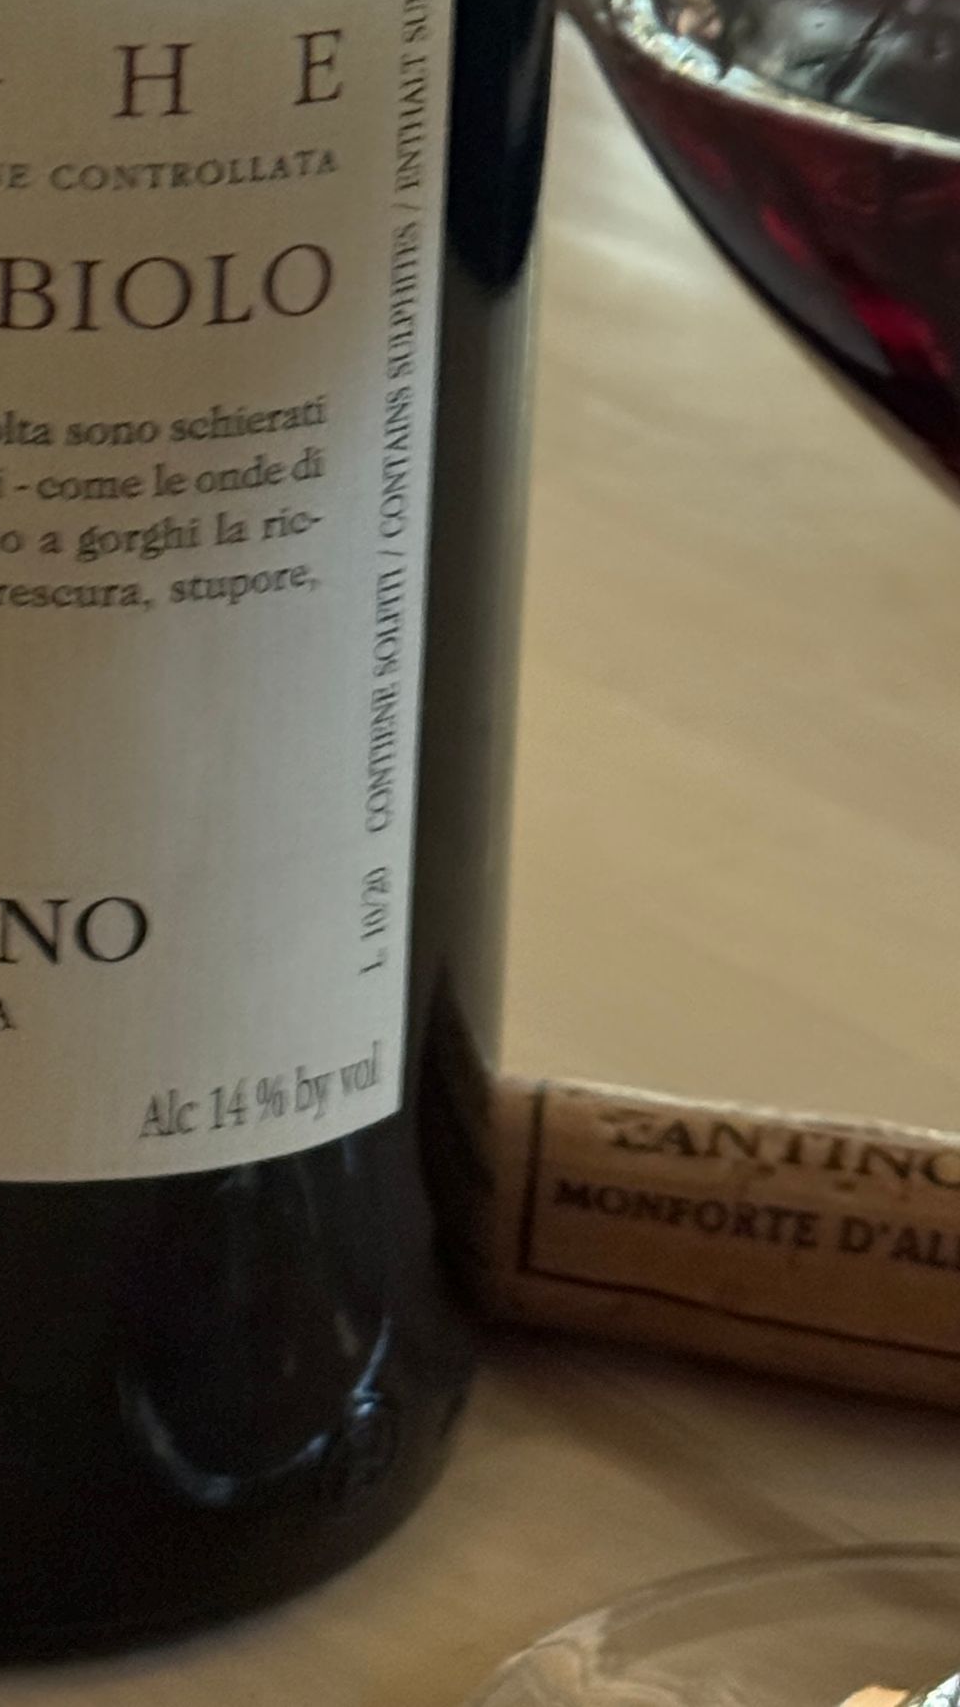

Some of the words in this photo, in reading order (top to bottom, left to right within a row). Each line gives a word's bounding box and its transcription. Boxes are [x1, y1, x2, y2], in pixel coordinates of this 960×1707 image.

[49, 150, 337, 191] CONTROLLATA
[384, 222, 421, 380] SULPHITES
[64, 417, 160, 447] sono
[170, 394, 328, 443] schierati
[37, 472, 141, 501] come
[152, 461, 187, 496] le
[194, 454, 284, 493] onde
[290, 445, 325, 481] di
[378, 386, 414, 539] CONTAINS
[39, 528, 63, 555] a
[77, 516, 200, 562] gorghi
[214, 511, 248, 546] la
[260, 508, 322, 541] ric-
[169, 560, 321, 606] stupore,
[365, 682, 402, 834] CONTIENE
[139, 1088, 194, 1139] Alc
[209, 1078, 246, 1129] 14
[254, 1073, 287, 1121] %
[294, 1065, 337, 1122] by
[340, 1039, 382, 1092] vol
[554, 1177, 821, 1250] MONFORTE
[838, 1214, 960, 1271] D'AL
